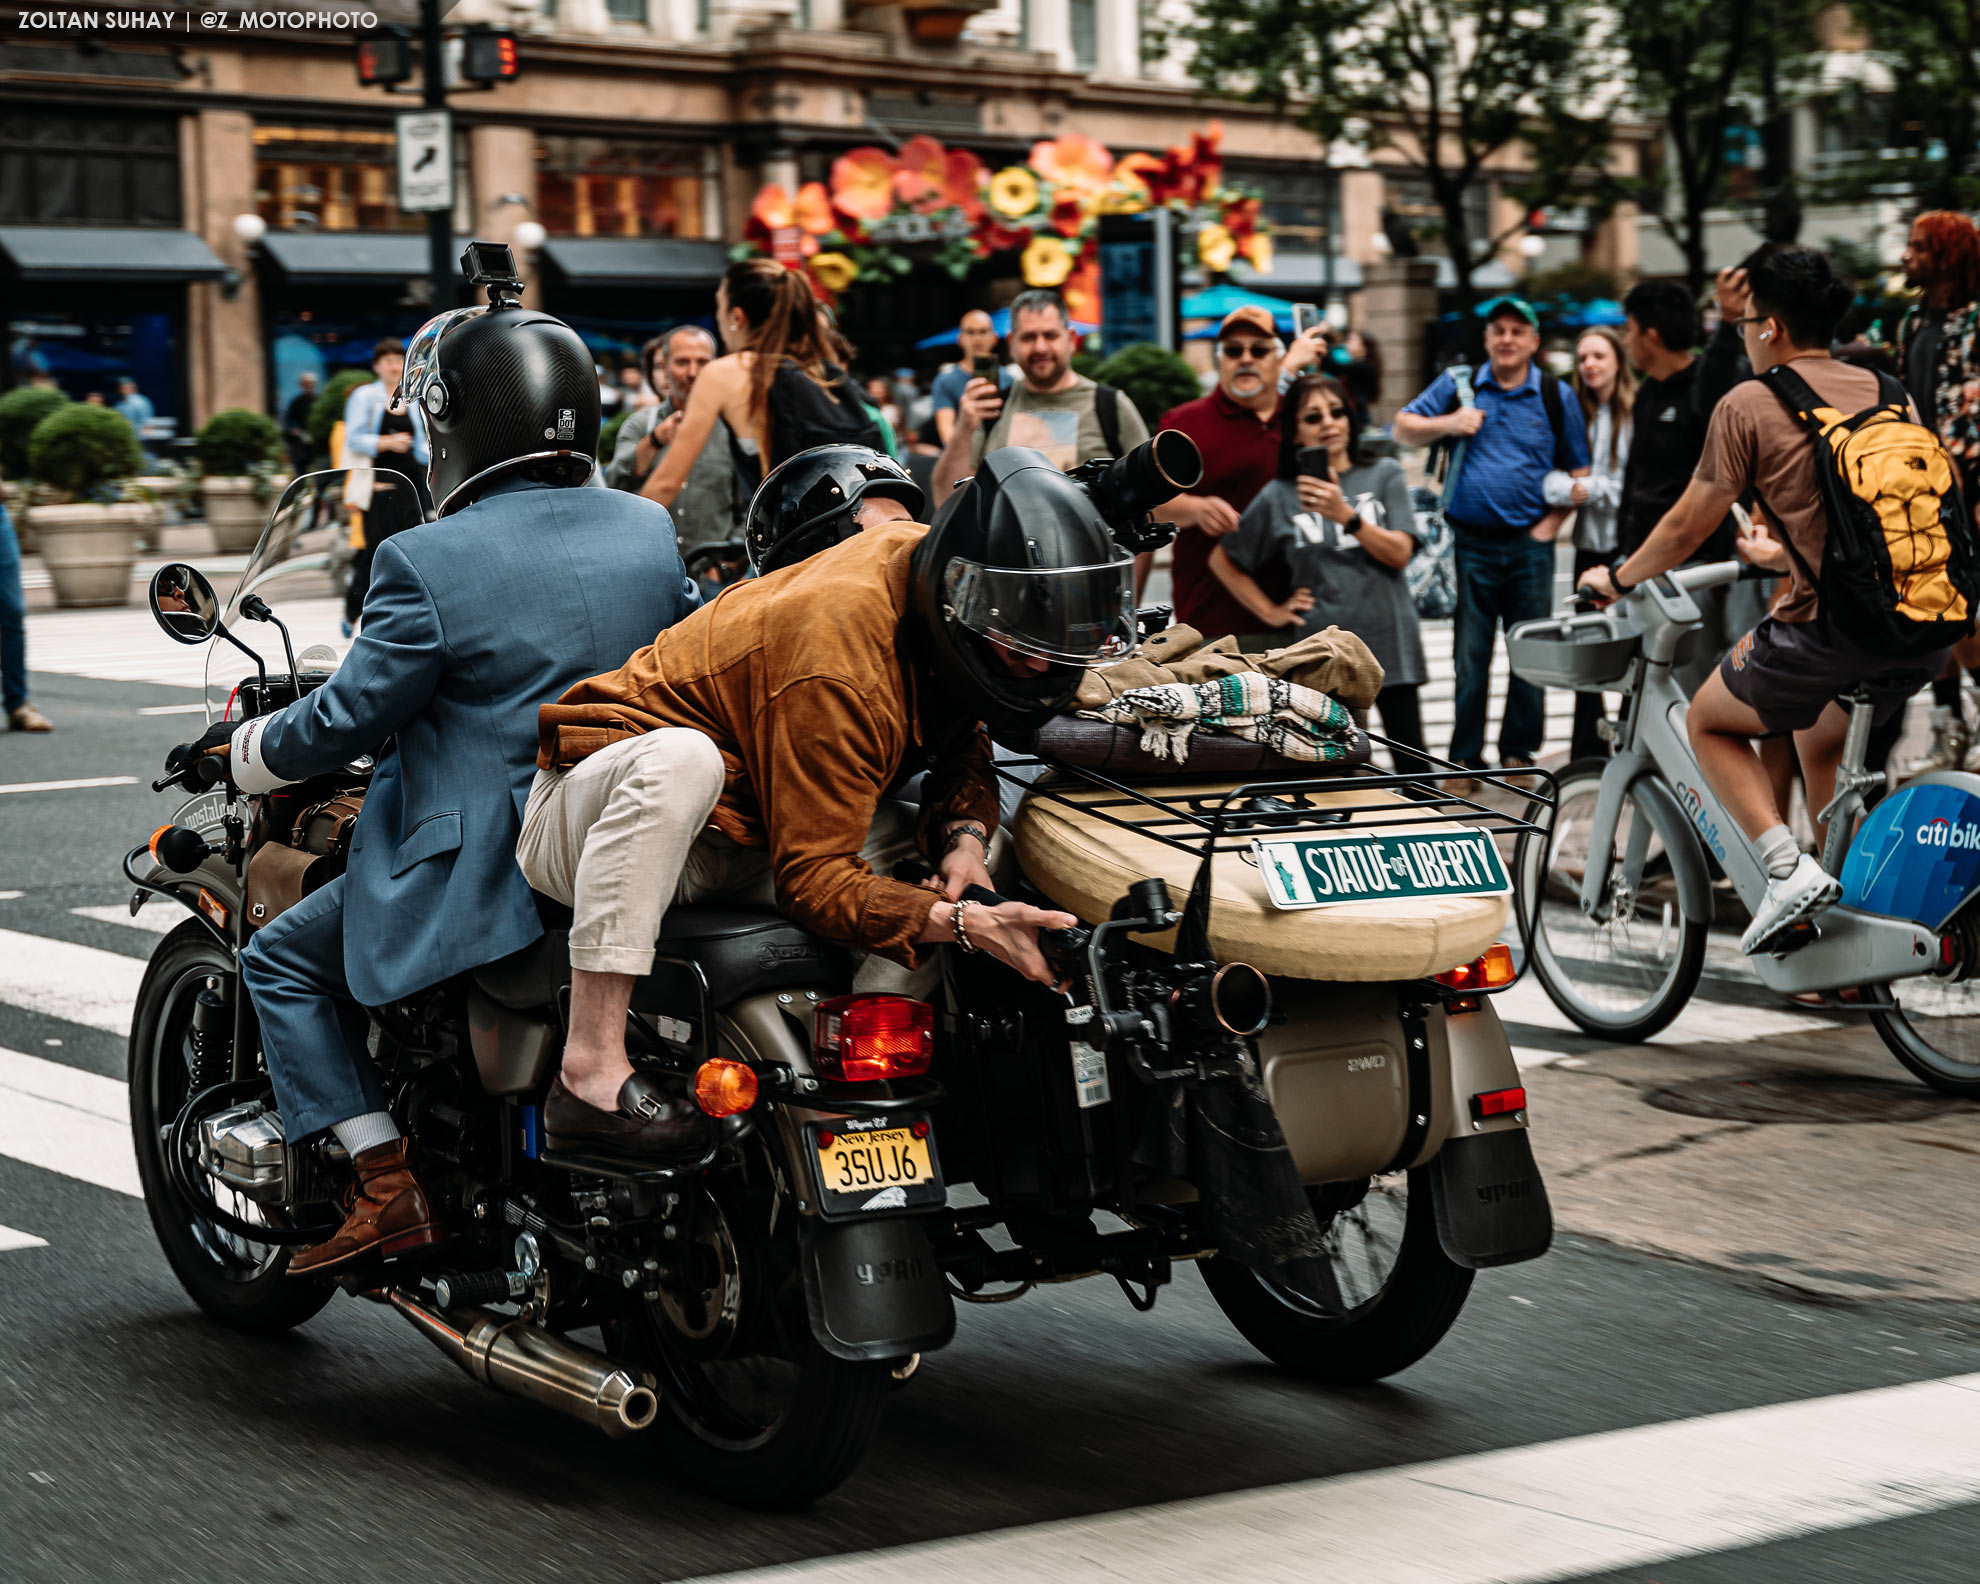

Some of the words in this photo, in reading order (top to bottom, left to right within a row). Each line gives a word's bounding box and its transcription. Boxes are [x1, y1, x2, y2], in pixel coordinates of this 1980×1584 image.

[559, 419, 575, 429] DOT
[1677, 781, 1701, 817] citi
[1697, 809, 1726, 861] bike
[1916, 818, 1949, 847] citi
[1949, 821, 1980, 851] bik
[1306, 844, 1401, 896] STATUE
[1390, 856, 1407, 877] OF
[1398, 839, 1496, 889] LIBERTY
[838, 1133, 866, 1146] New
[868, 1130, 905, 1146] Jersey
[835, 1144, 917, 1187] 3SUJ6
